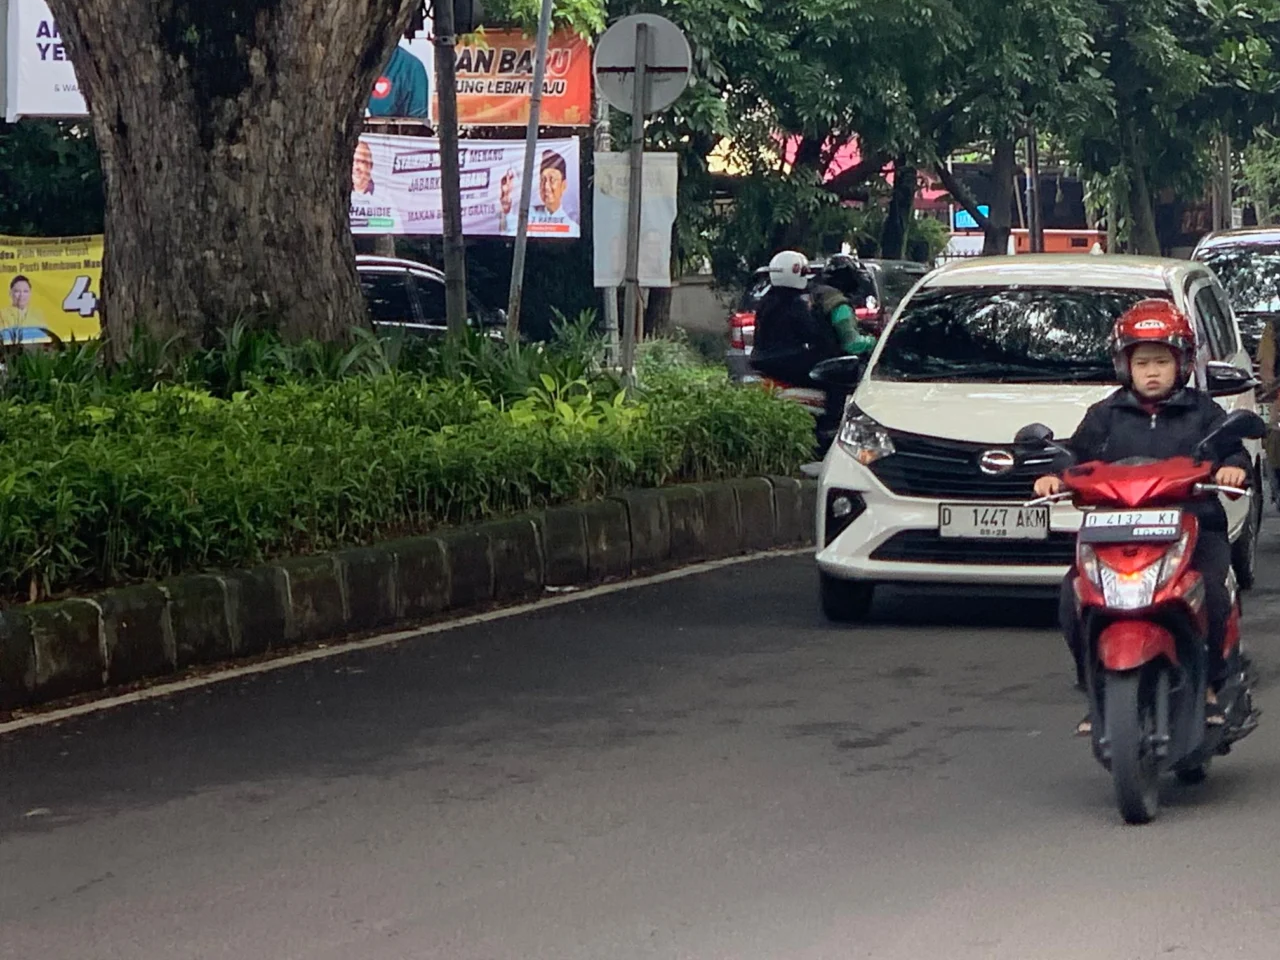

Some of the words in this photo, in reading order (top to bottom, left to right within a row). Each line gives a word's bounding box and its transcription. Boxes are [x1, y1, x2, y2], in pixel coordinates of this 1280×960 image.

[488, 81, 526, 94] LEBIH
[62, 275, 95, 317] 4
[942, 507, 952, 526] D
[973, 508, 1008, 527] 1447
[1015, 508, 1047, 528] AKM
[1089, 515, 1098, 525] D
[1106, 513, 1143, 526] 4132
